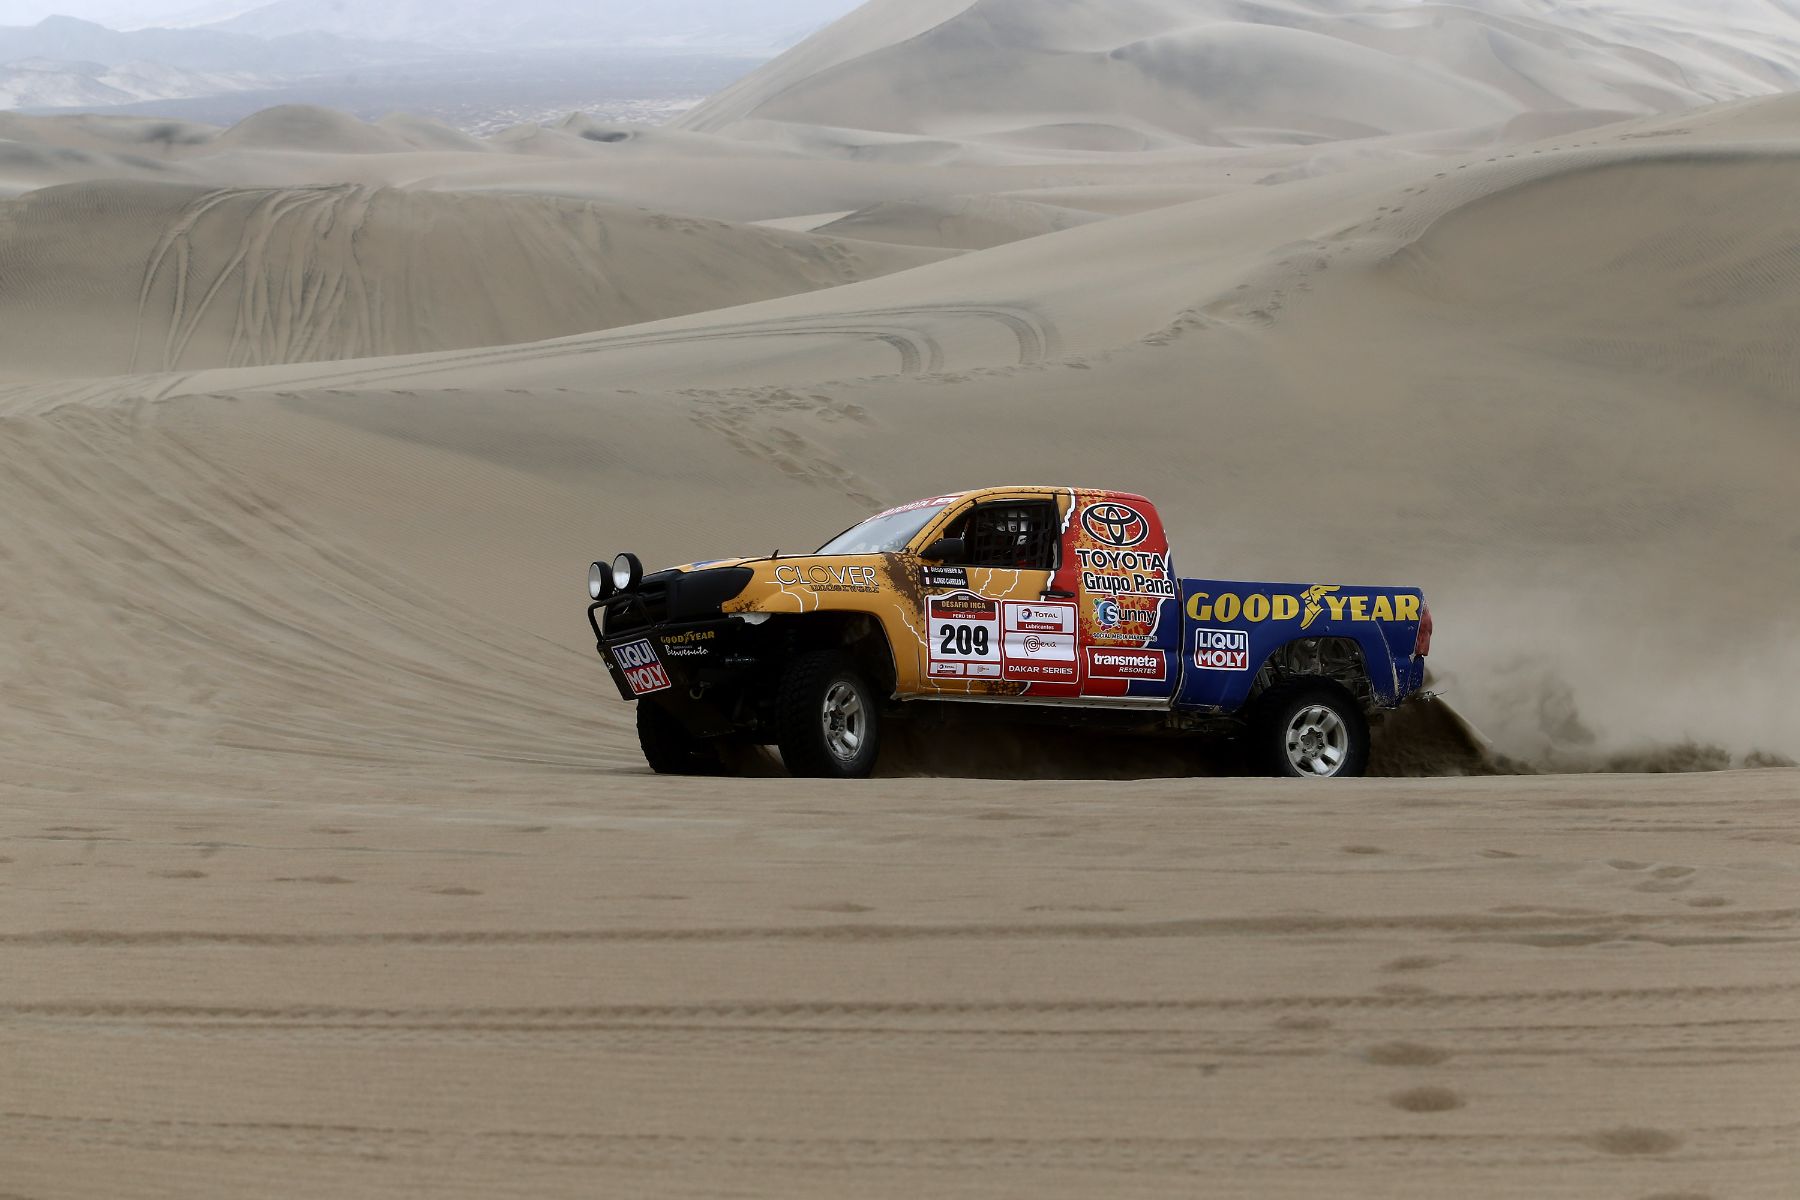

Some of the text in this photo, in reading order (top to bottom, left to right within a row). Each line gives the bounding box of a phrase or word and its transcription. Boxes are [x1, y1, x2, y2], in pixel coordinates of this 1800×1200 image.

[1076, 549, 1167, 572] TOYOTA
[774, 565, 879, 587] CLOVER
[1083, 571, 1174, 596] Grupo Pana
[1034, 611, 1059, 619] TOTAL
[1025, 623, 1055, 631] Lubricantes
[939, 623, 989, 656] 209
[1128, 634, 1158, 642] MARKETING
[1199, 632, 1245, 650] LIQUI
[614, 642, 656, 669] LIQUI
[1093, 653, 1157, 668] transmeta
[1197, 649, 1246, 667] MOLY
[626, 664, 667, 692] MOLY
[1008, 665, 1073, 675] DAKAR SERIES
[1118, 667, 1157, 675] RESORTES
